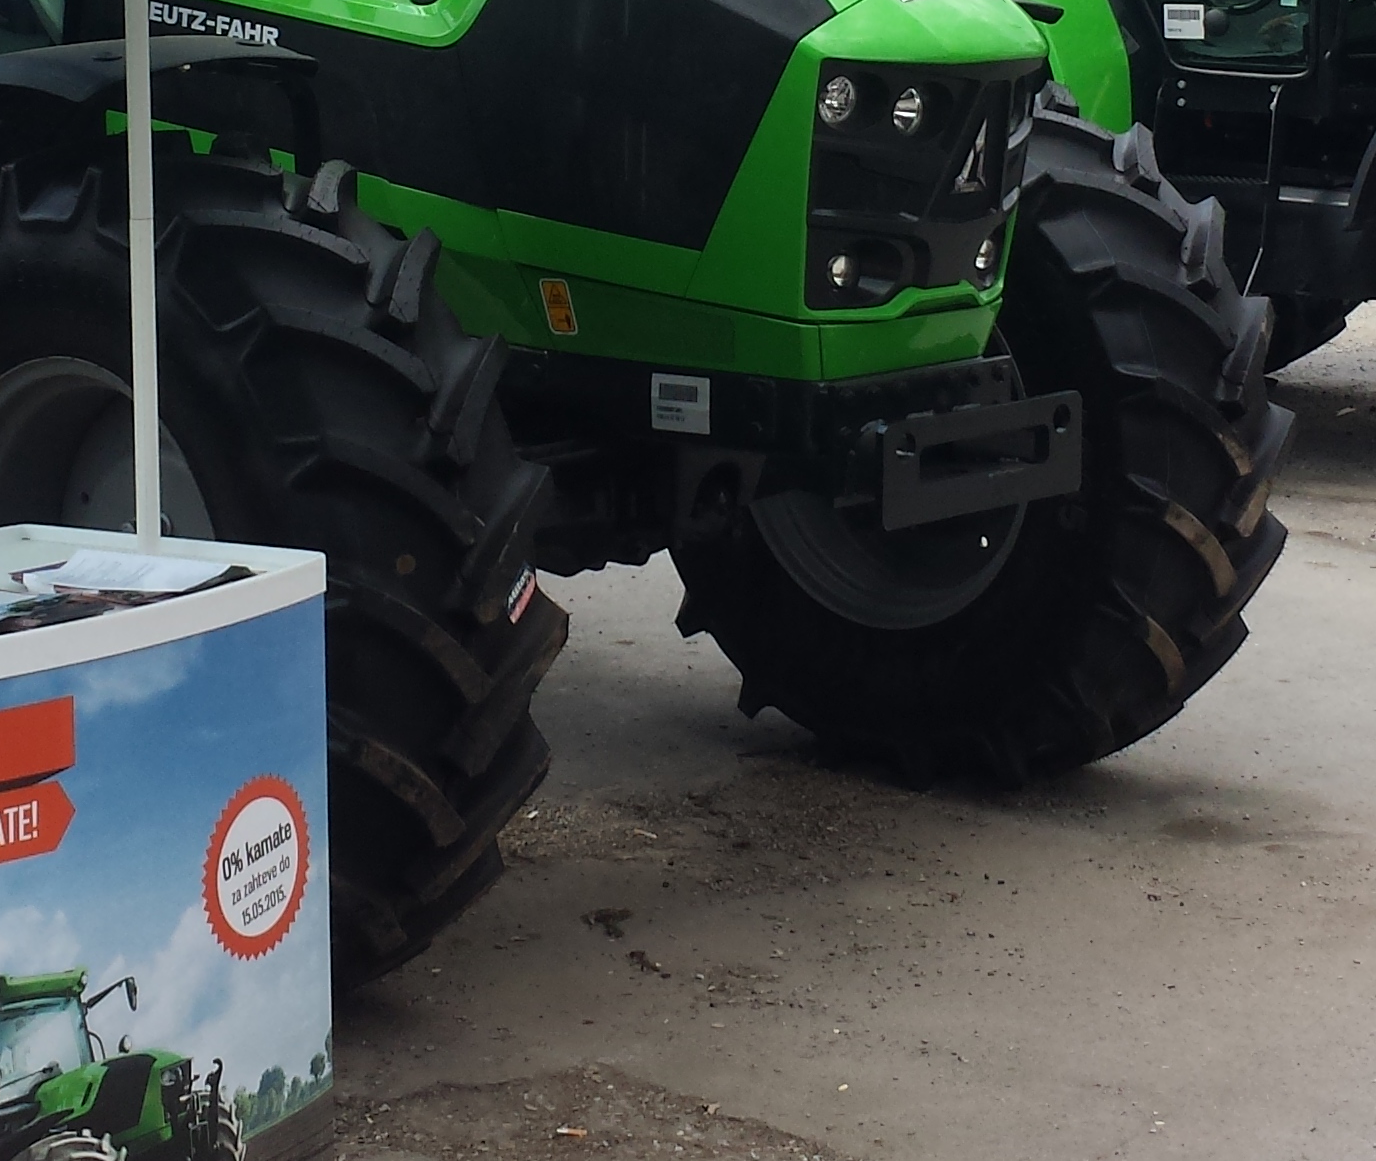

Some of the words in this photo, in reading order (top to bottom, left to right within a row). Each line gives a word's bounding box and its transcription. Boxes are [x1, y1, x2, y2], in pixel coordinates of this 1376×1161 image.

[149, 1, 280, 46] EUTZ-FAHR
[222, 847, 244, 882] 0%
[245, 822, 292, 867] kamate
[231, 887, 242, 906] za
[243, 864, 277, 898] zahteve
[279, 854, 291, 874] do
[241, 884, 287, 927] 15.05.2015.
